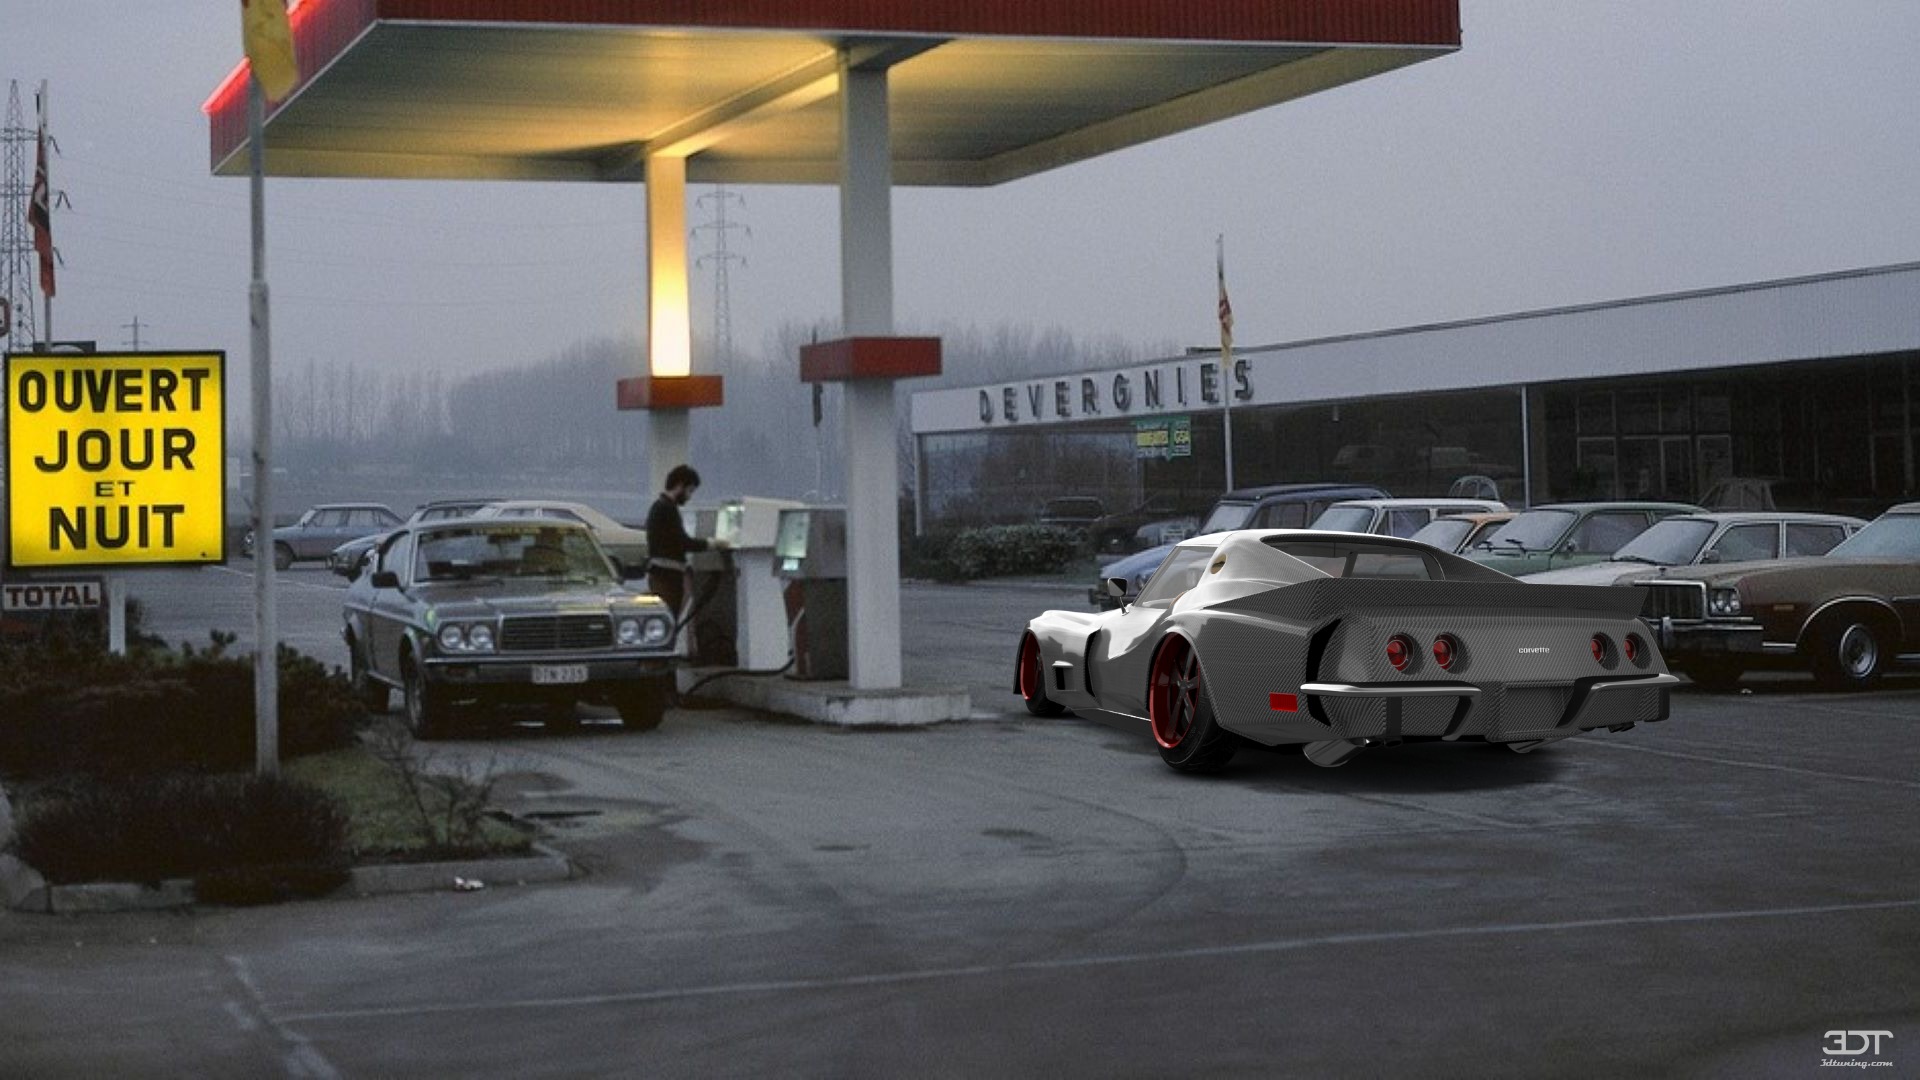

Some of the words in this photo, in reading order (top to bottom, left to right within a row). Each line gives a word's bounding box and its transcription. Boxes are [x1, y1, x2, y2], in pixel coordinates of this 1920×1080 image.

[18, 368, 210, 413] OUVERT
[979, 359, 1252, 424] DEVERGNIES
[34, 428, 196, 473] JOUR
[95, 481, 136, 497] ET
[49, 504, 185, 550] NUIT
[5, 586, 98, 607] TOTAL
